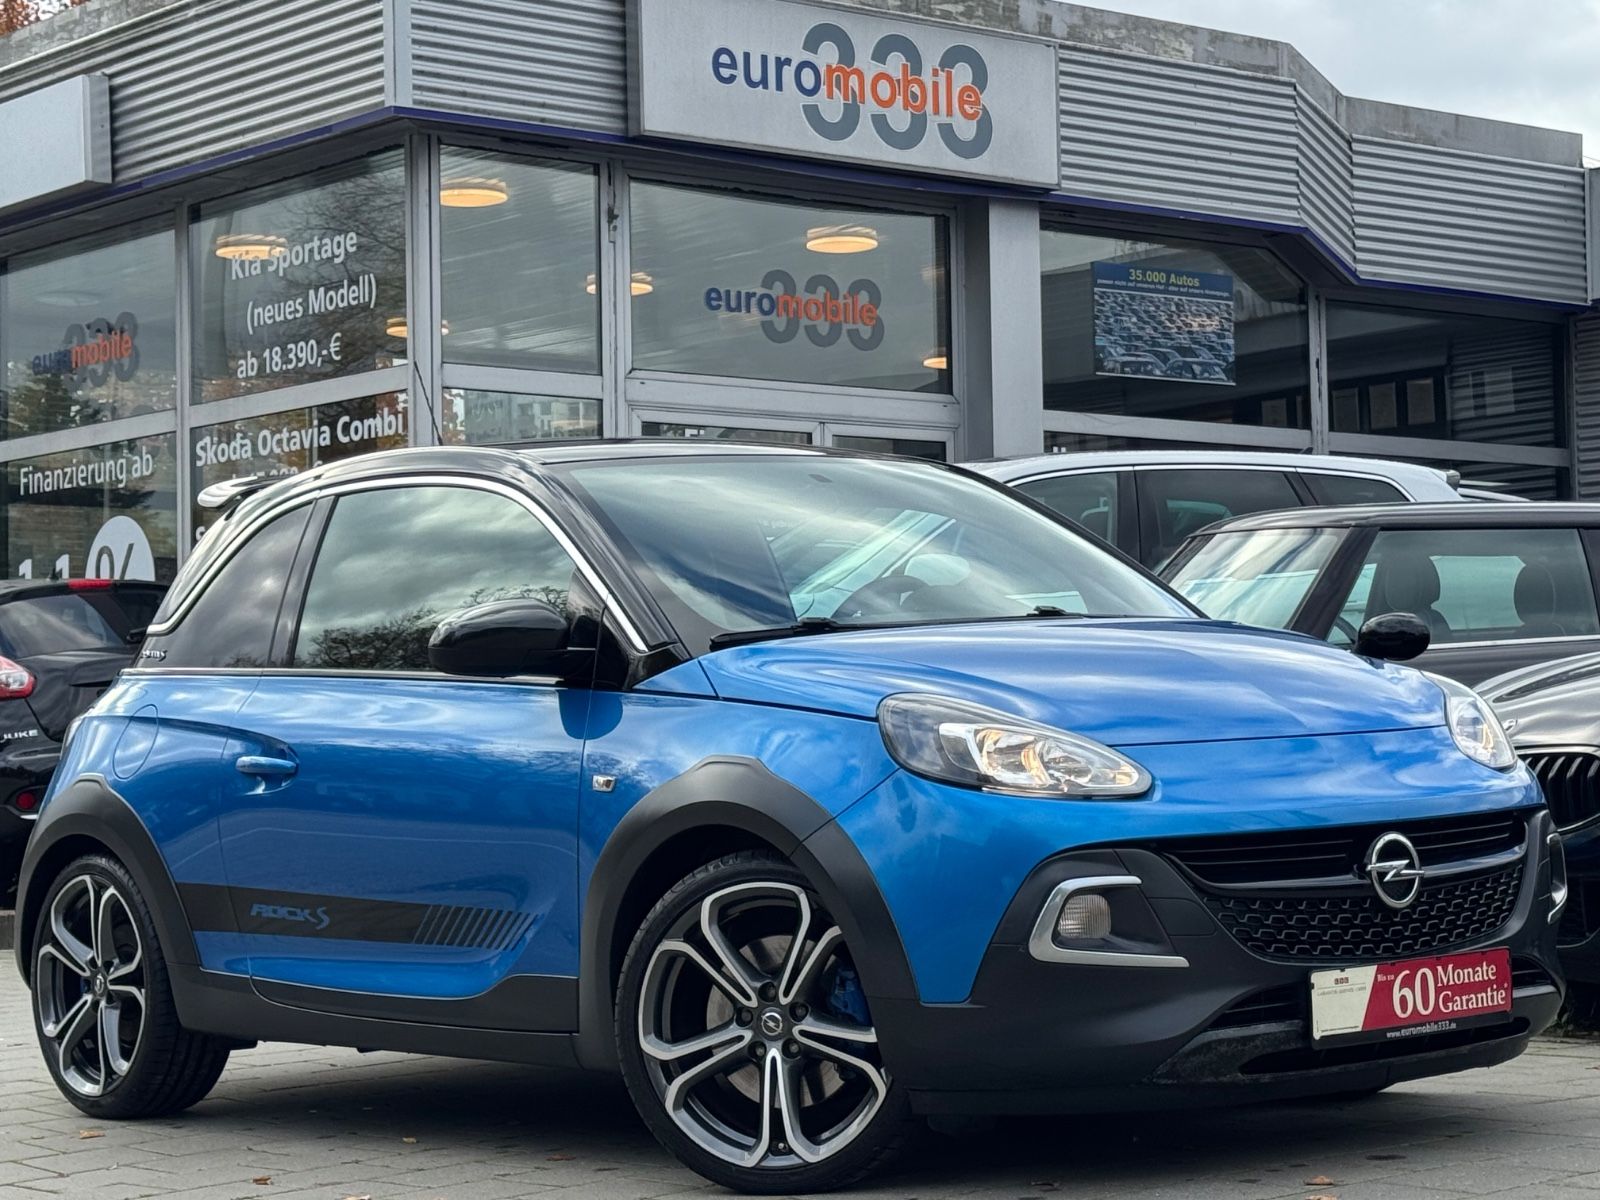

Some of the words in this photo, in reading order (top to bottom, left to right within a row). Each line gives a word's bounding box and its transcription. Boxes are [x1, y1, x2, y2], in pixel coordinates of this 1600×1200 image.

[711, 46, 983, 121] euromobile
[231, 248, 262, 280] Kia
[267, 231, 358, 277] Sportage
[1129, 269, 1166, 283] 35.000
[1169, 273, 1200, 287] Autos
[246, 298, 303, 335] (neues
[308, 273, 377, 315] Modell)
[704, 286, 878, 328] euromobile
[237, 351, 258, 378] ab
[257, 420, 331, 456] Octavia
[337, 407, 404, 443] Combi
[19, 457, 127, 496] Finanzierung
[131, 446, 153, 478] ab
[0, 729, 39, 743] JUKE
[1392, 967, 1436, 1018] 60
[1436, 961, 1497, 987] Monate
